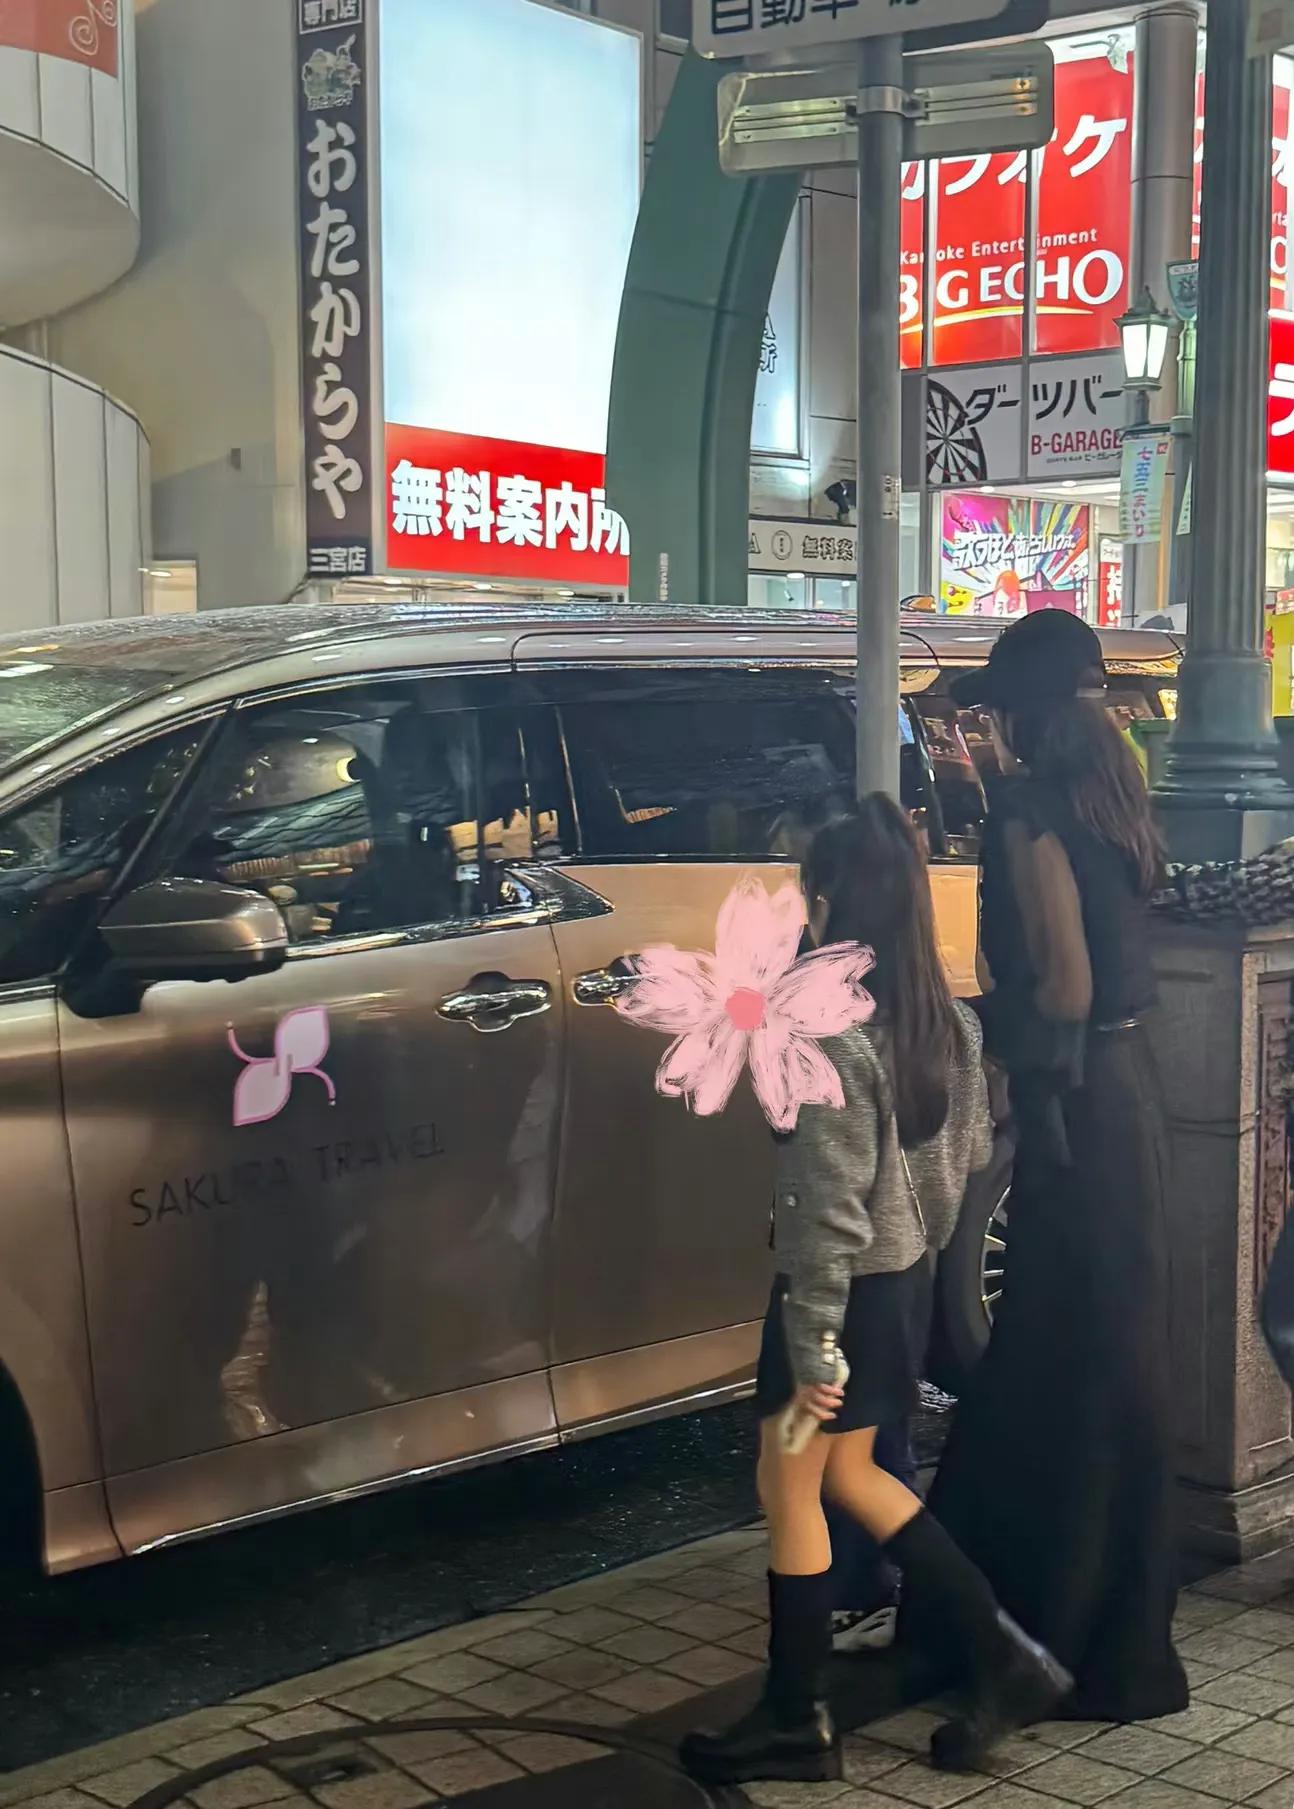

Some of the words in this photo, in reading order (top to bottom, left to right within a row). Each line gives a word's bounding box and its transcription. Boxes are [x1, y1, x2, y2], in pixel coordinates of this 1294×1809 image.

[900, 245, 965, 265] Kaoke
[971, 228, 1098, 257] Entertinment
[900, 269, 969, 325] BG
[979, 249, 1124, 305] ECHO
[306, 119, 362, 519] おたからや
[966, 375, 1123, 427] ダーツバー
[1031, 428, 1123, 456] B-GARAGE
[391, 459, 630, 556] 無料案内所
[310, 547, 367, 573] 三宮店
[802, 535, 857, 561] 無料案
